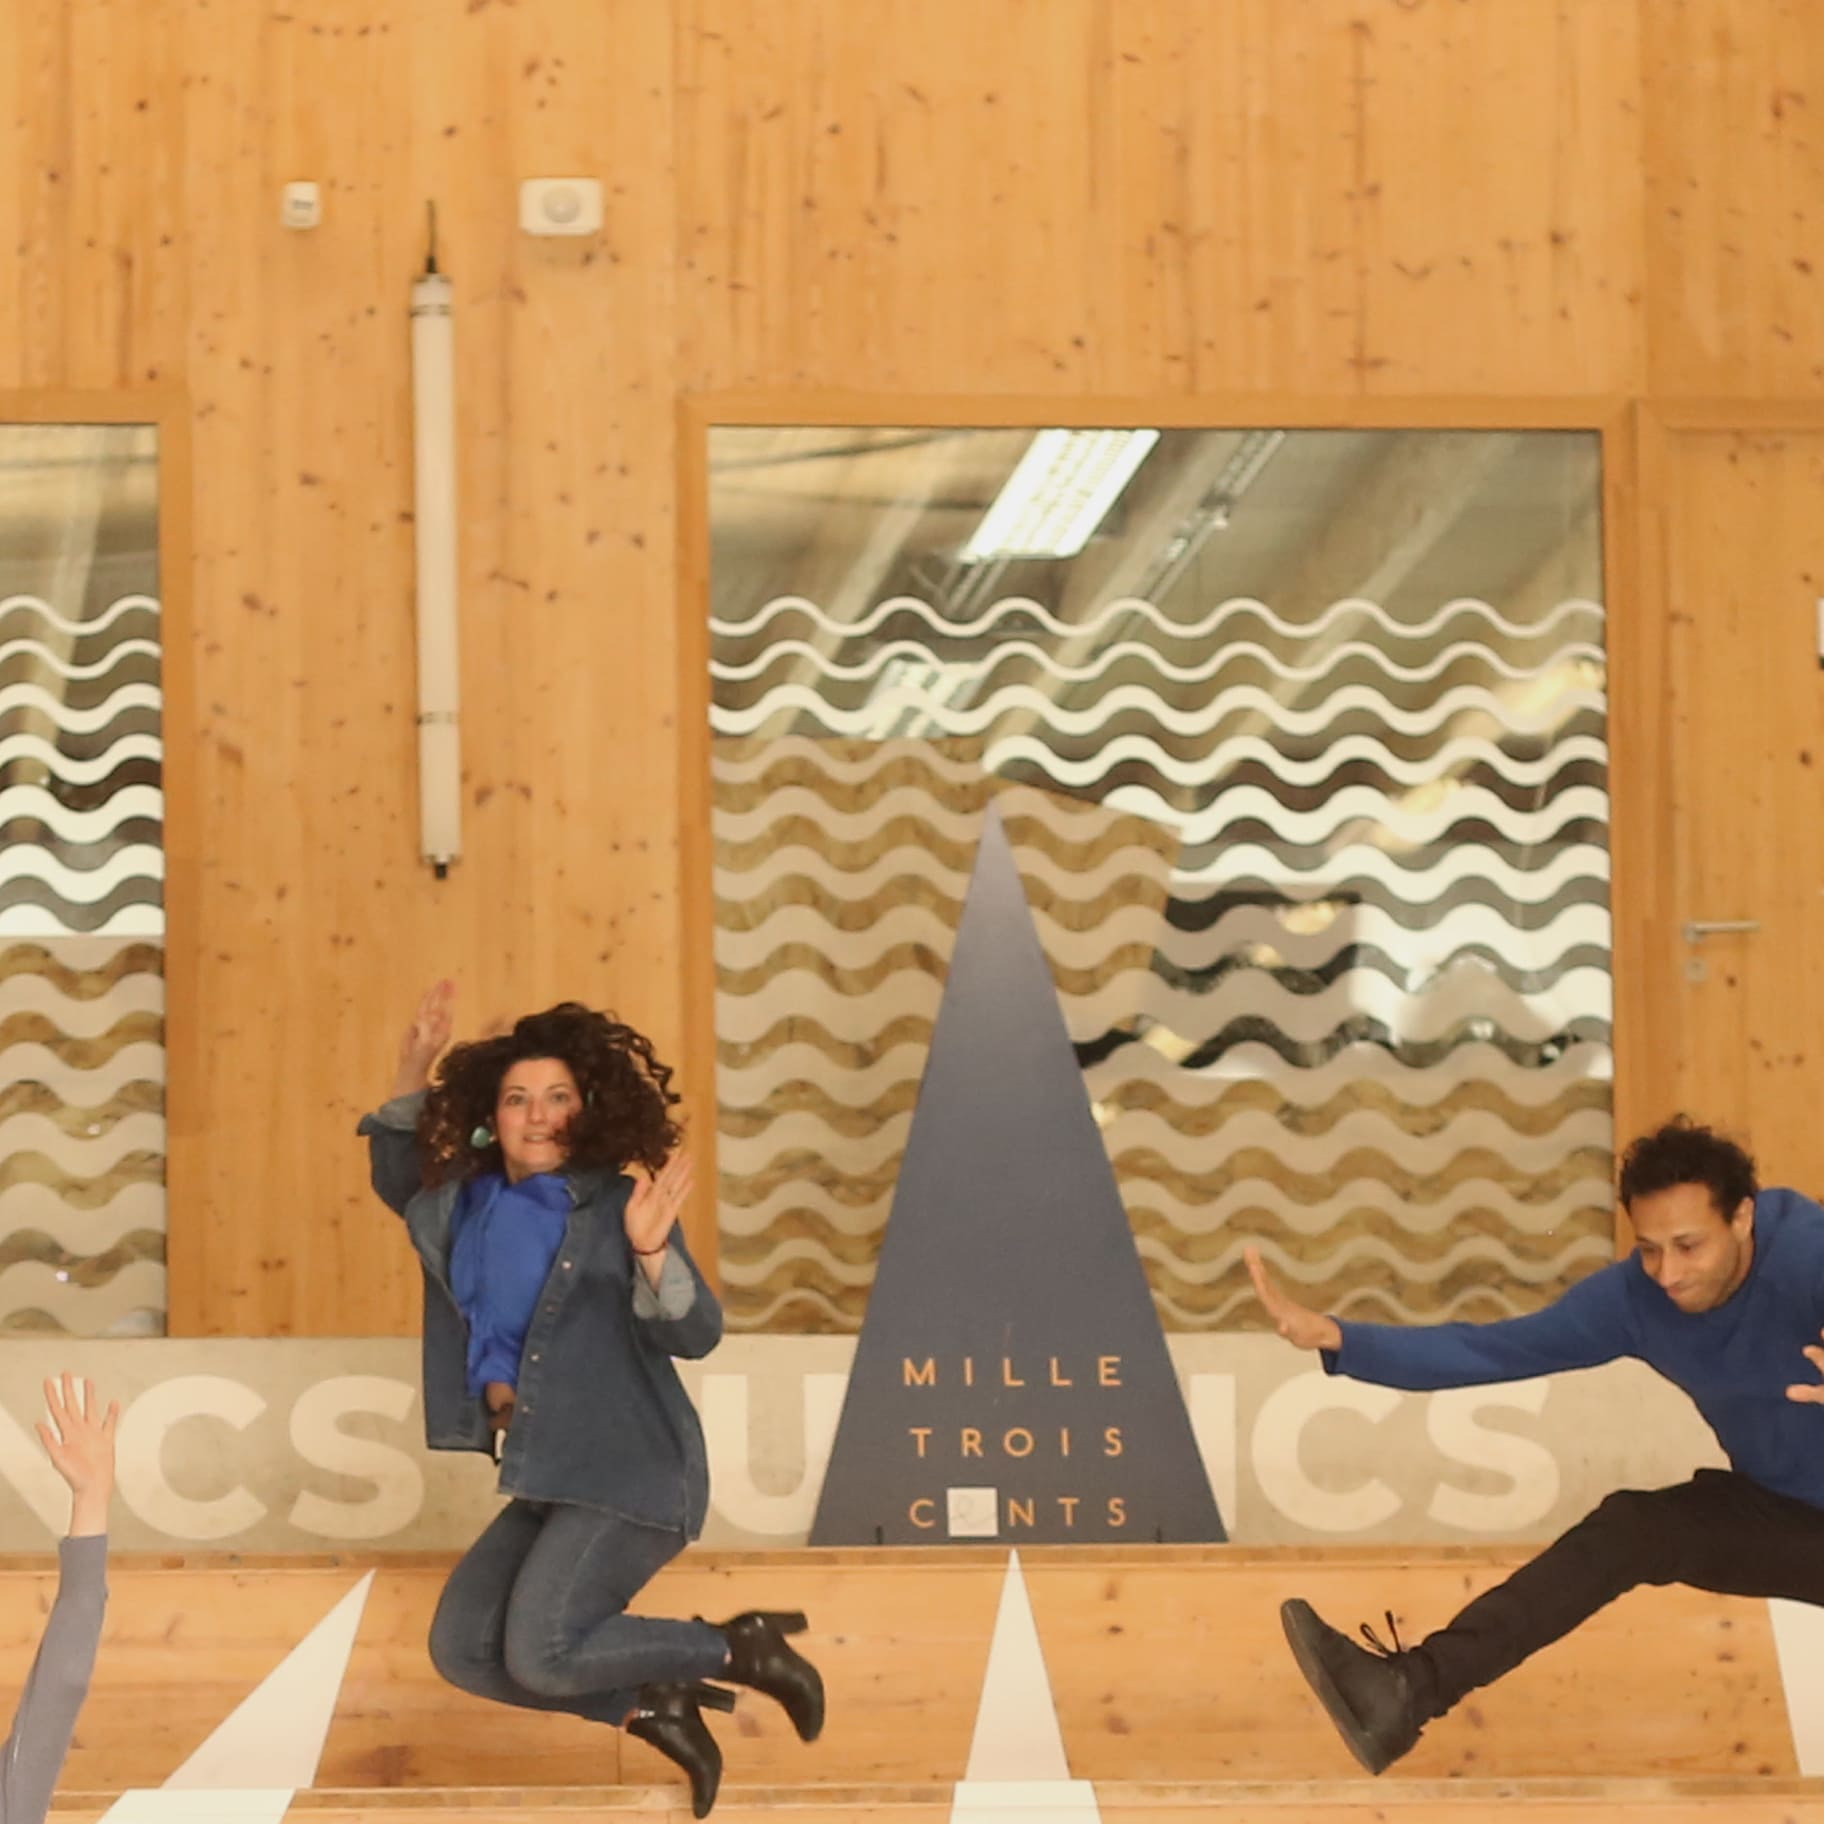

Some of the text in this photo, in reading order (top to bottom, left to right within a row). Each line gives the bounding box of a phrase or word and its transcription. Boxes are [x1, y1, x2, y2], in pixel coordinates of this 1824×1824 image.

[903, 1357, 1122, 1387] MILLE
[908, 1427, 1124, 1457] TROIS
[909, 1498, 1127, 1529] CNTS
